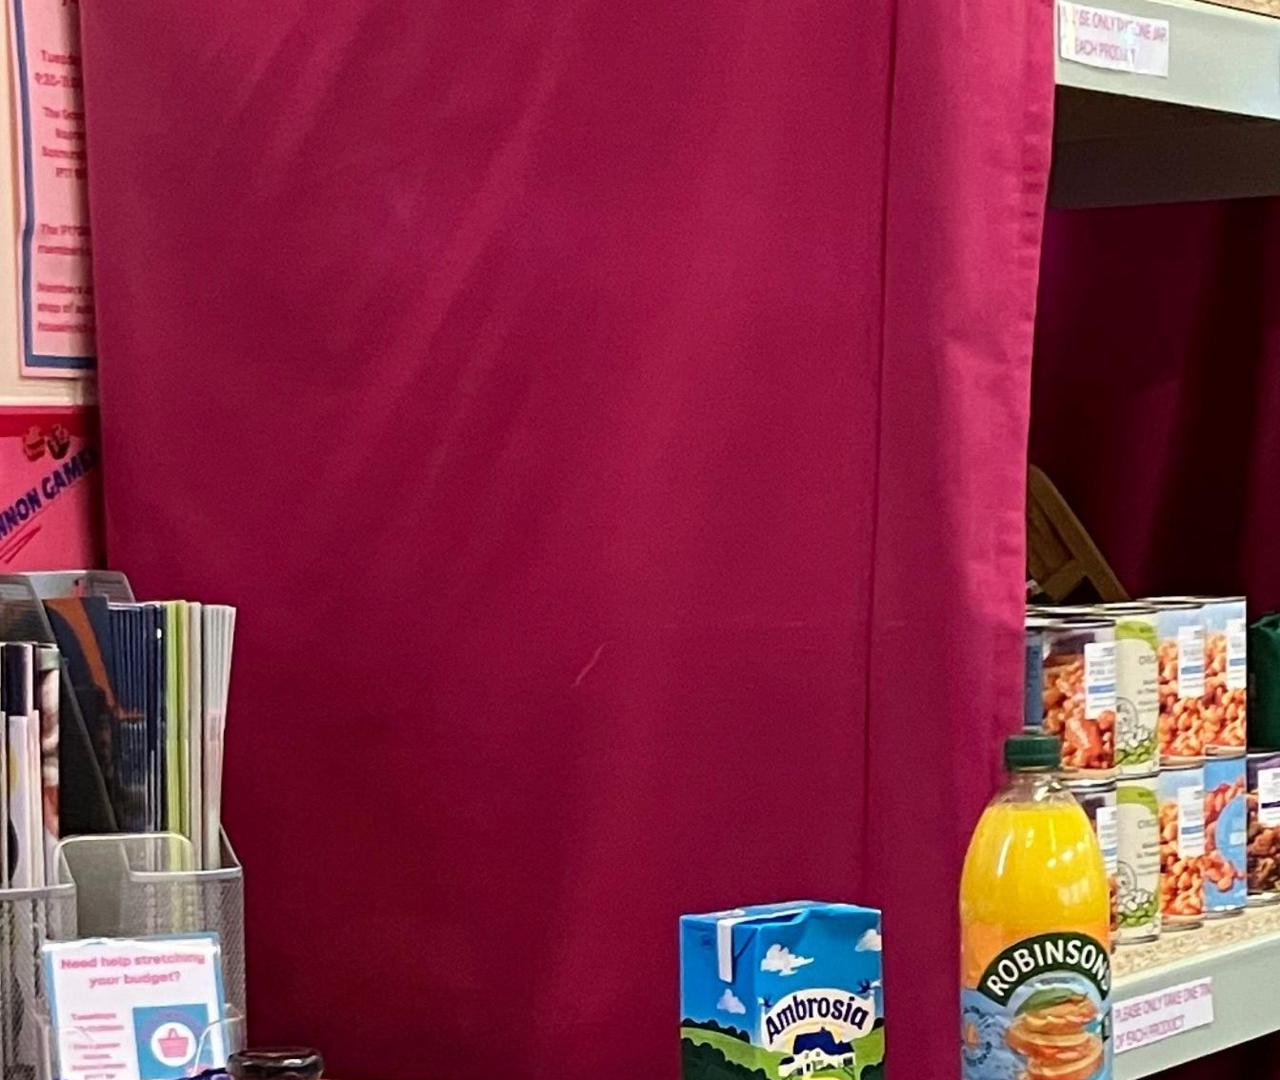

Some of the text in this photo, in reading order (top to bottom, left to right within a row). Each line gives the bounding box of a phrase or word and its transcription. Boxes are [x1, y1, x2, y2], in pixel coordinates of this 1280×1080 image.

[42, 446, 96, 500] GAM
[61, 953, 206, 969] Need help stretching
[89, 970, 181, 989] your budget?
[765, 995, 870, 1045] Ambrosia
